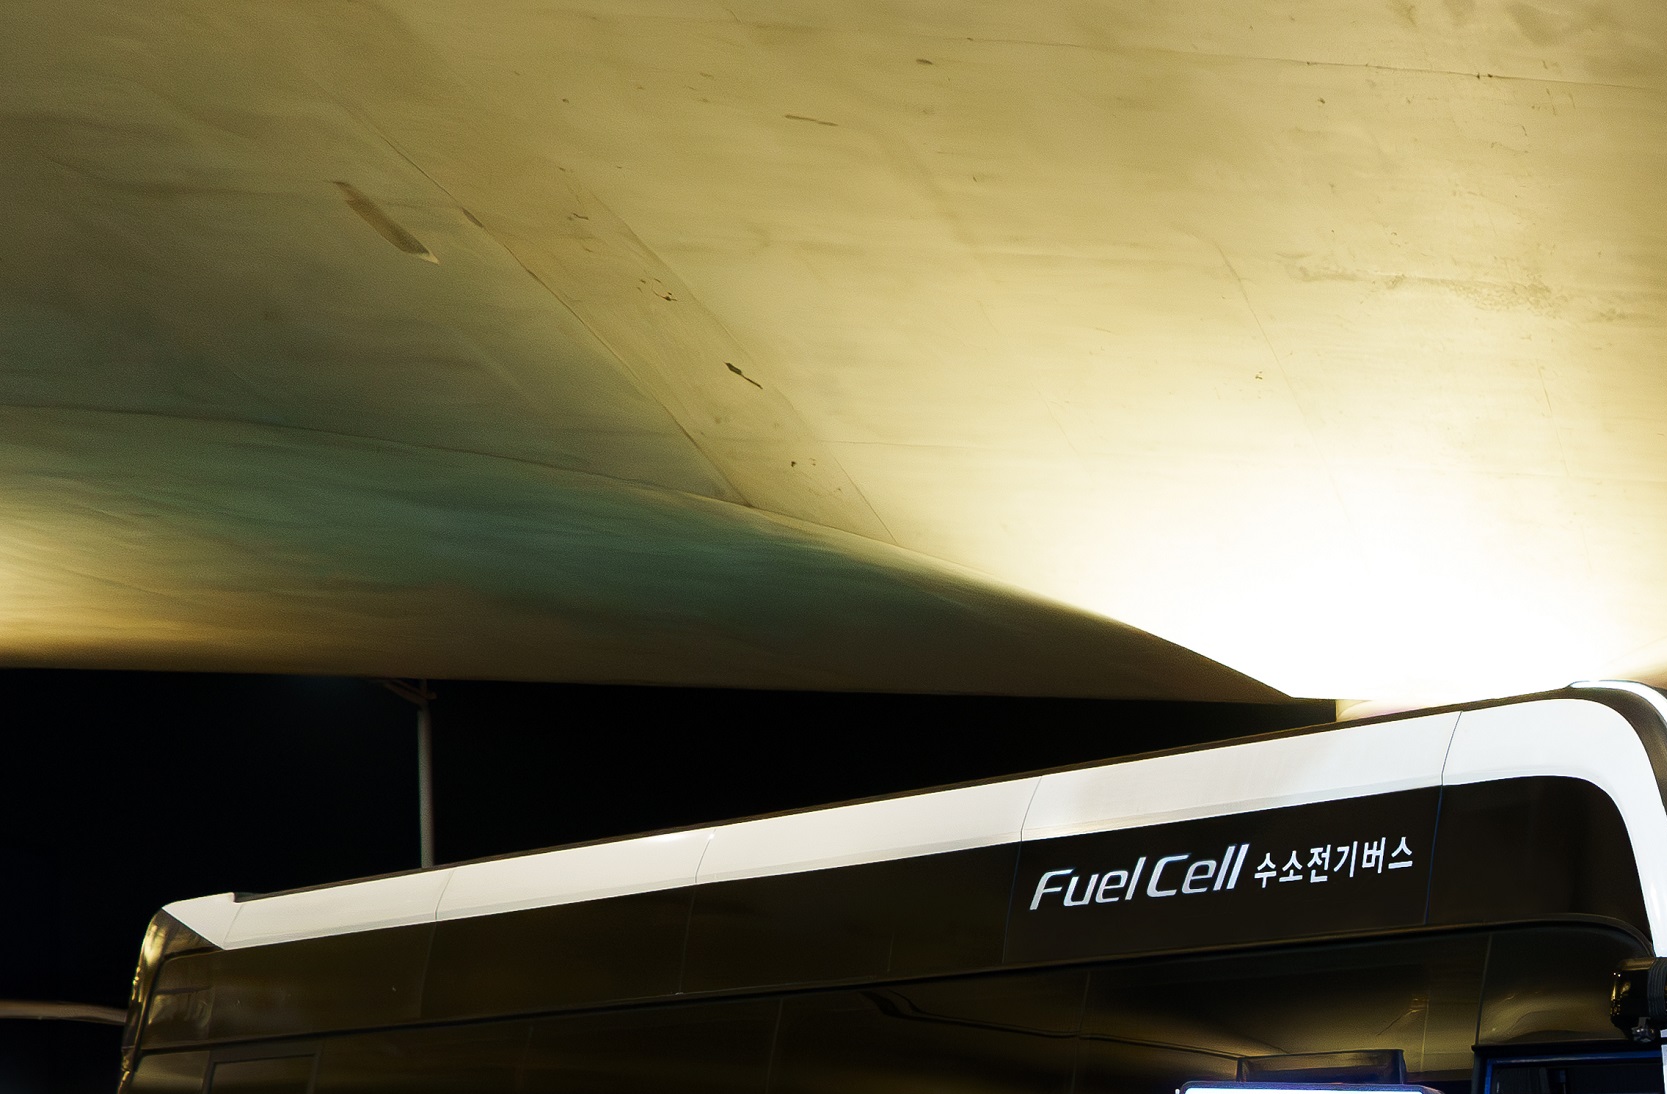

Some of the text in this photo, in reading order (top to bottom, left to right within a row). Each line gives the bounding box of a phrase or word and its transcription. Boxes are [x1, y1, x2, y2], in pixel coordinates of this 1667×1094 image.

[1029, 836, 1413, 910] Fuel Cell 수소전기버스
